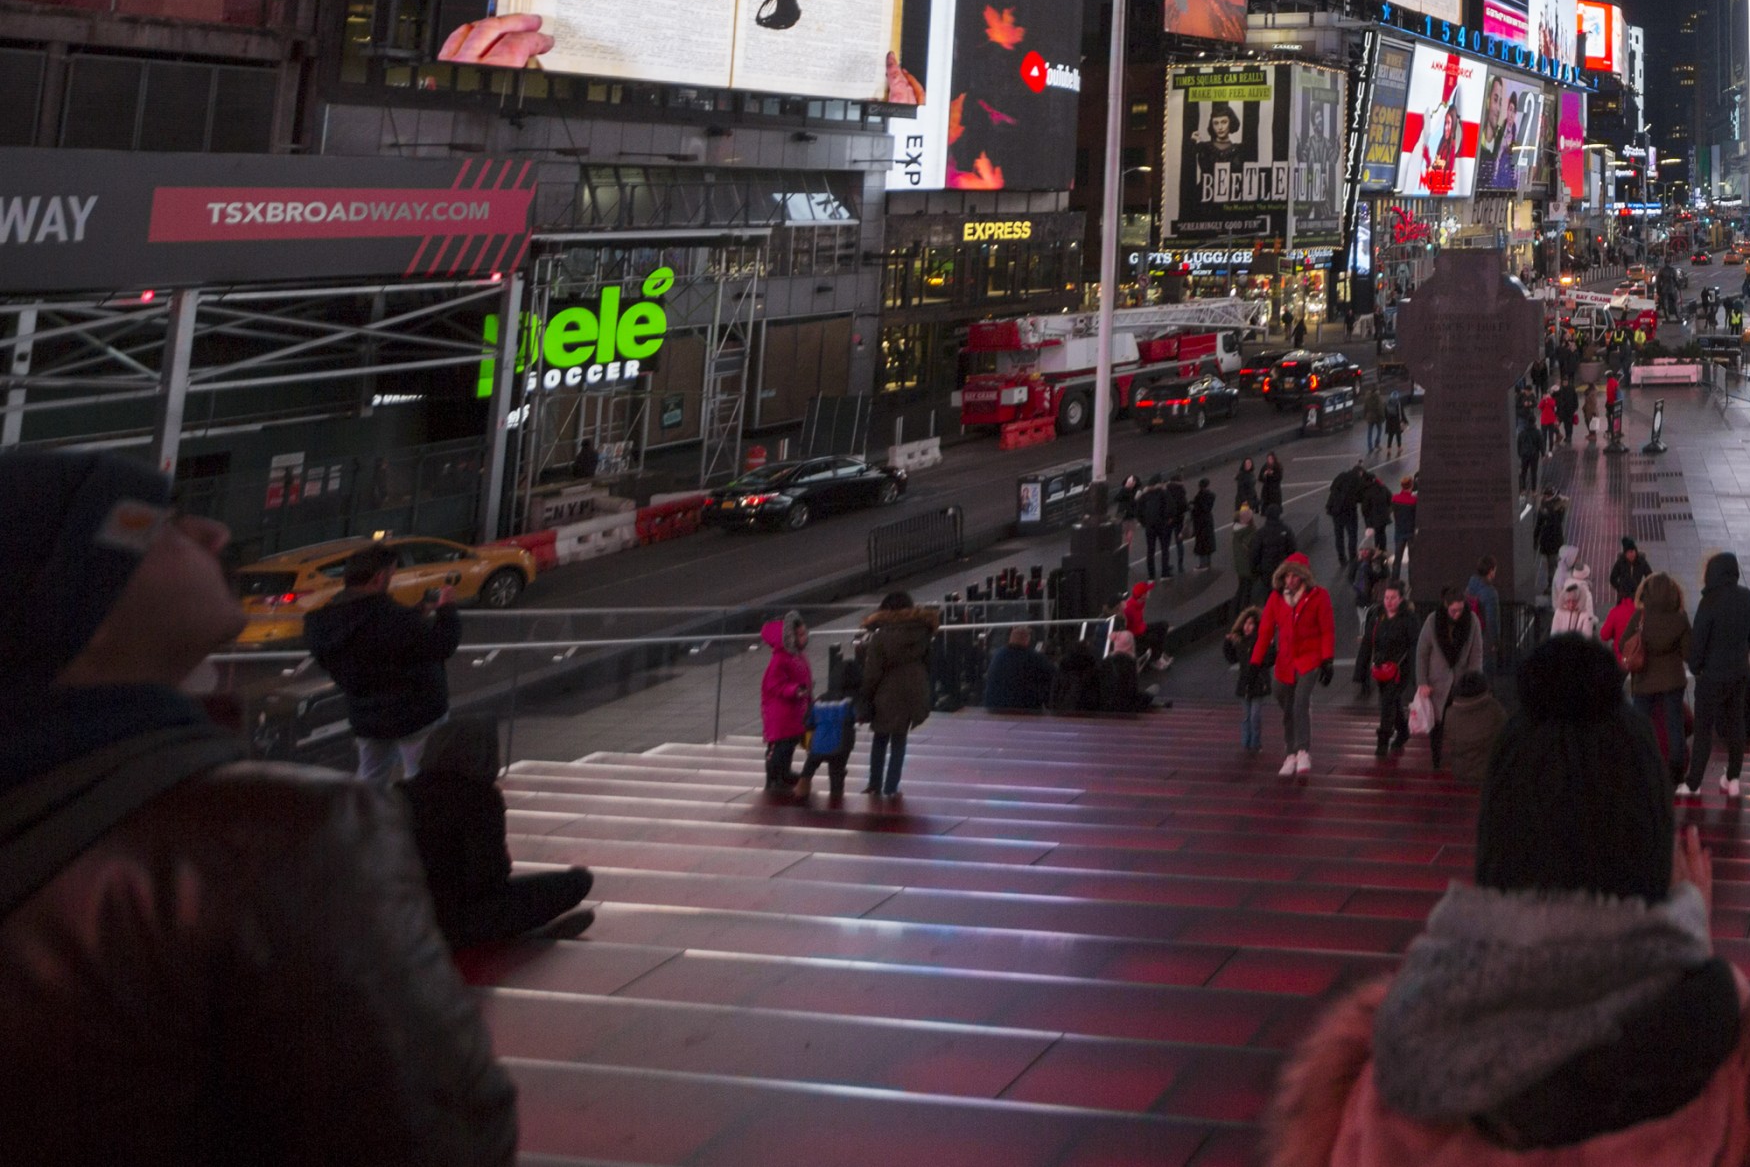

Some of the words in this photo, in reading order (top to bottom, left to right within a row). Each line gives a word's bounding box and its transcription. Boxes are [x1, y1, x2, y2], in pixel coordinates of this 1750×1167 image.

[1425, 14, 1482, 52] 1540
[1487, 35, 1582, 85] BROADWAY
[1431, 60, 1448, 72] ANNA
[1175, 75, 1196, 86] TIMES
[1196, 73, 1222, 85] SQUARE
[1223, 73, 1238, 84] CAN
[1239, 72, 1265, 83] REALLY
[1191, 89, 1212, 100] MAKE
[1213, 88, 1227, 98] YOU
[1229, 87, 1246, 98] FEEL
[1372, 104, 1401, 127] COME
[1519, 91, 1544, 168] 21
[905, 134, 923, 187] EXP
[1366, 143, 1398, 164] AWAY
[206, 200, 490, 225] TSXBROADWAY.COM
[962, 220, 1032, 242] EXPRESS
[1224, 219, 1244, 231] GOOD
[1590, 295, 1612, 304] CRANE
[525, 359, 641, 392] SOCCER
